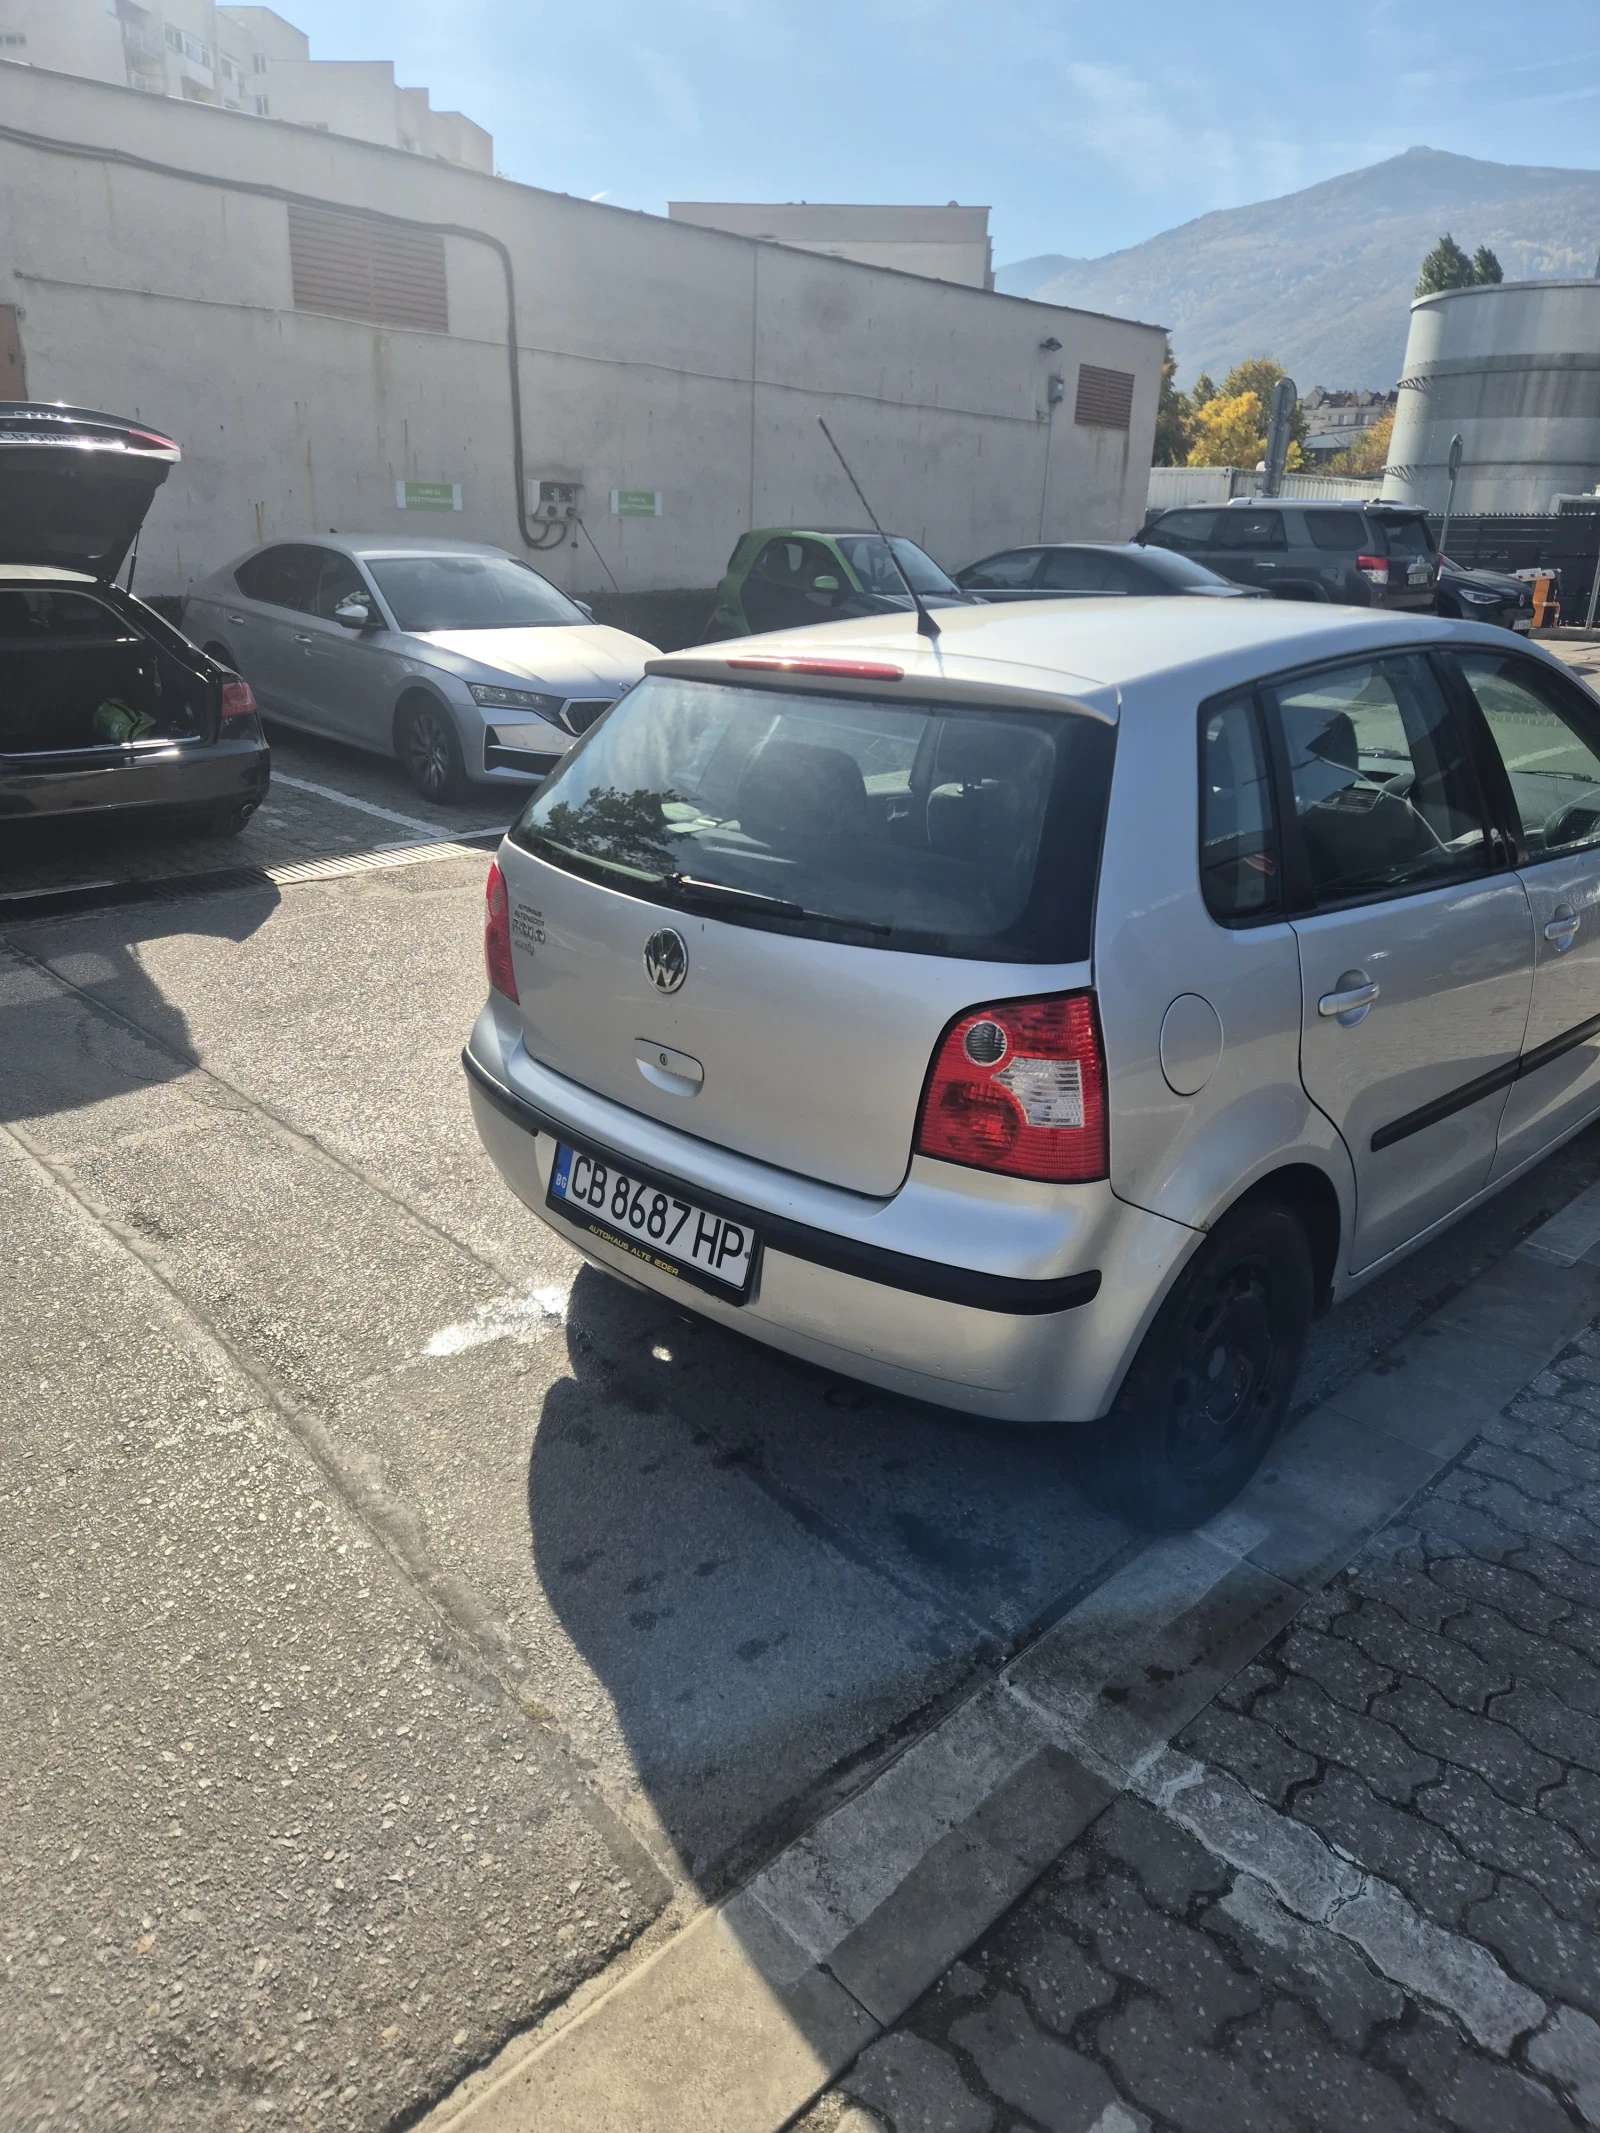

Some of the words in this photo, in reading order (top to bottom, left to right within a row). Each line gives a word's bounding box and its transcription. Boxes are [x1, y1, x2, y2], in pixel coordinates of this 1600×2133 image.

[518, 903, 542, 917] AUTOHAUS
[644, 928, 688, 993] VW
[555, 1173, 567, 1189] BG
[571, 1155, 608, 1209] CB
[610, 1176, 692, 1246] 8687
[692, 1212, 745, 1269] HP
[588, 1224, 629, 1251] AUTOHAUS
